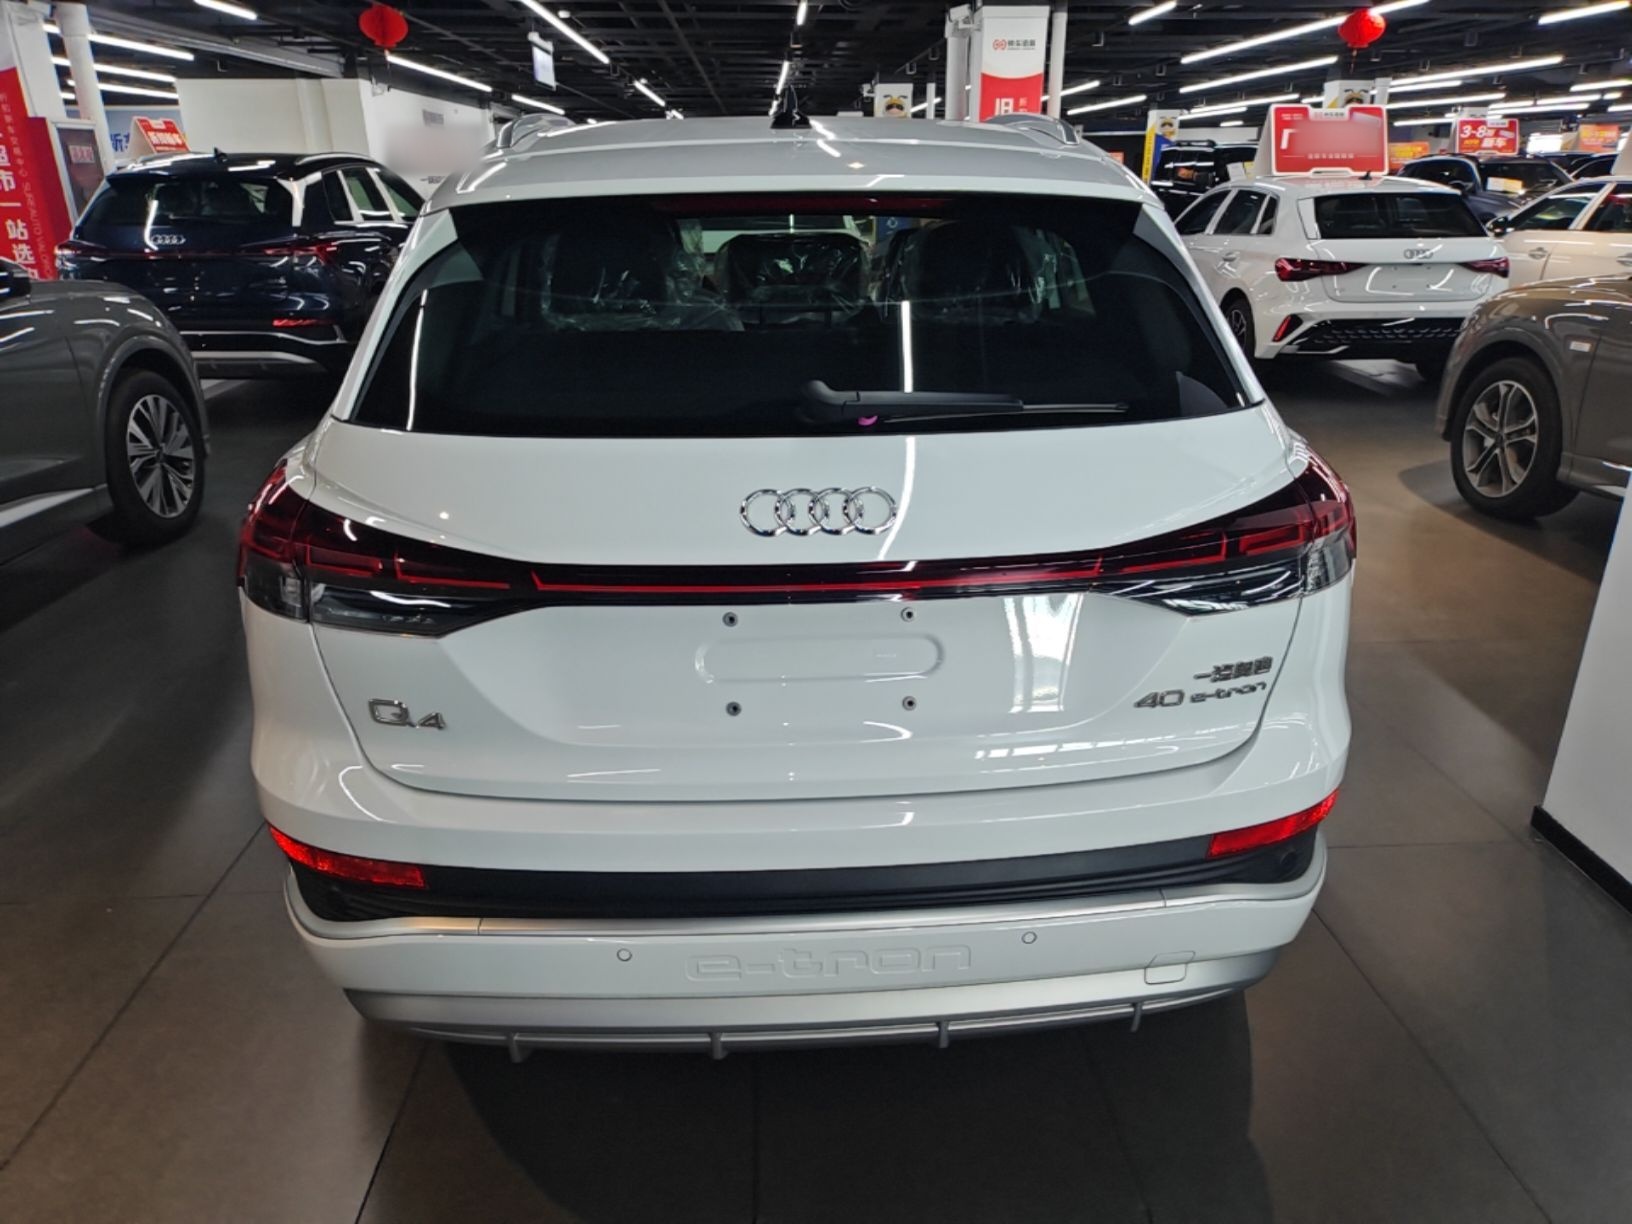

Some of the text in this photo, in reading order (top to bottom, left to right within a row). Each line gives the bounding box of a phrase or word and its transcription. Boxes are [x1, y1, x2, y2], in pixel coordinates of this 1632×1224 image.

[1133, 681, 1267, 708] 40 e-tron
[368, 698, 446, 730] Q4
[685, 943, 971, 982] e-tron
